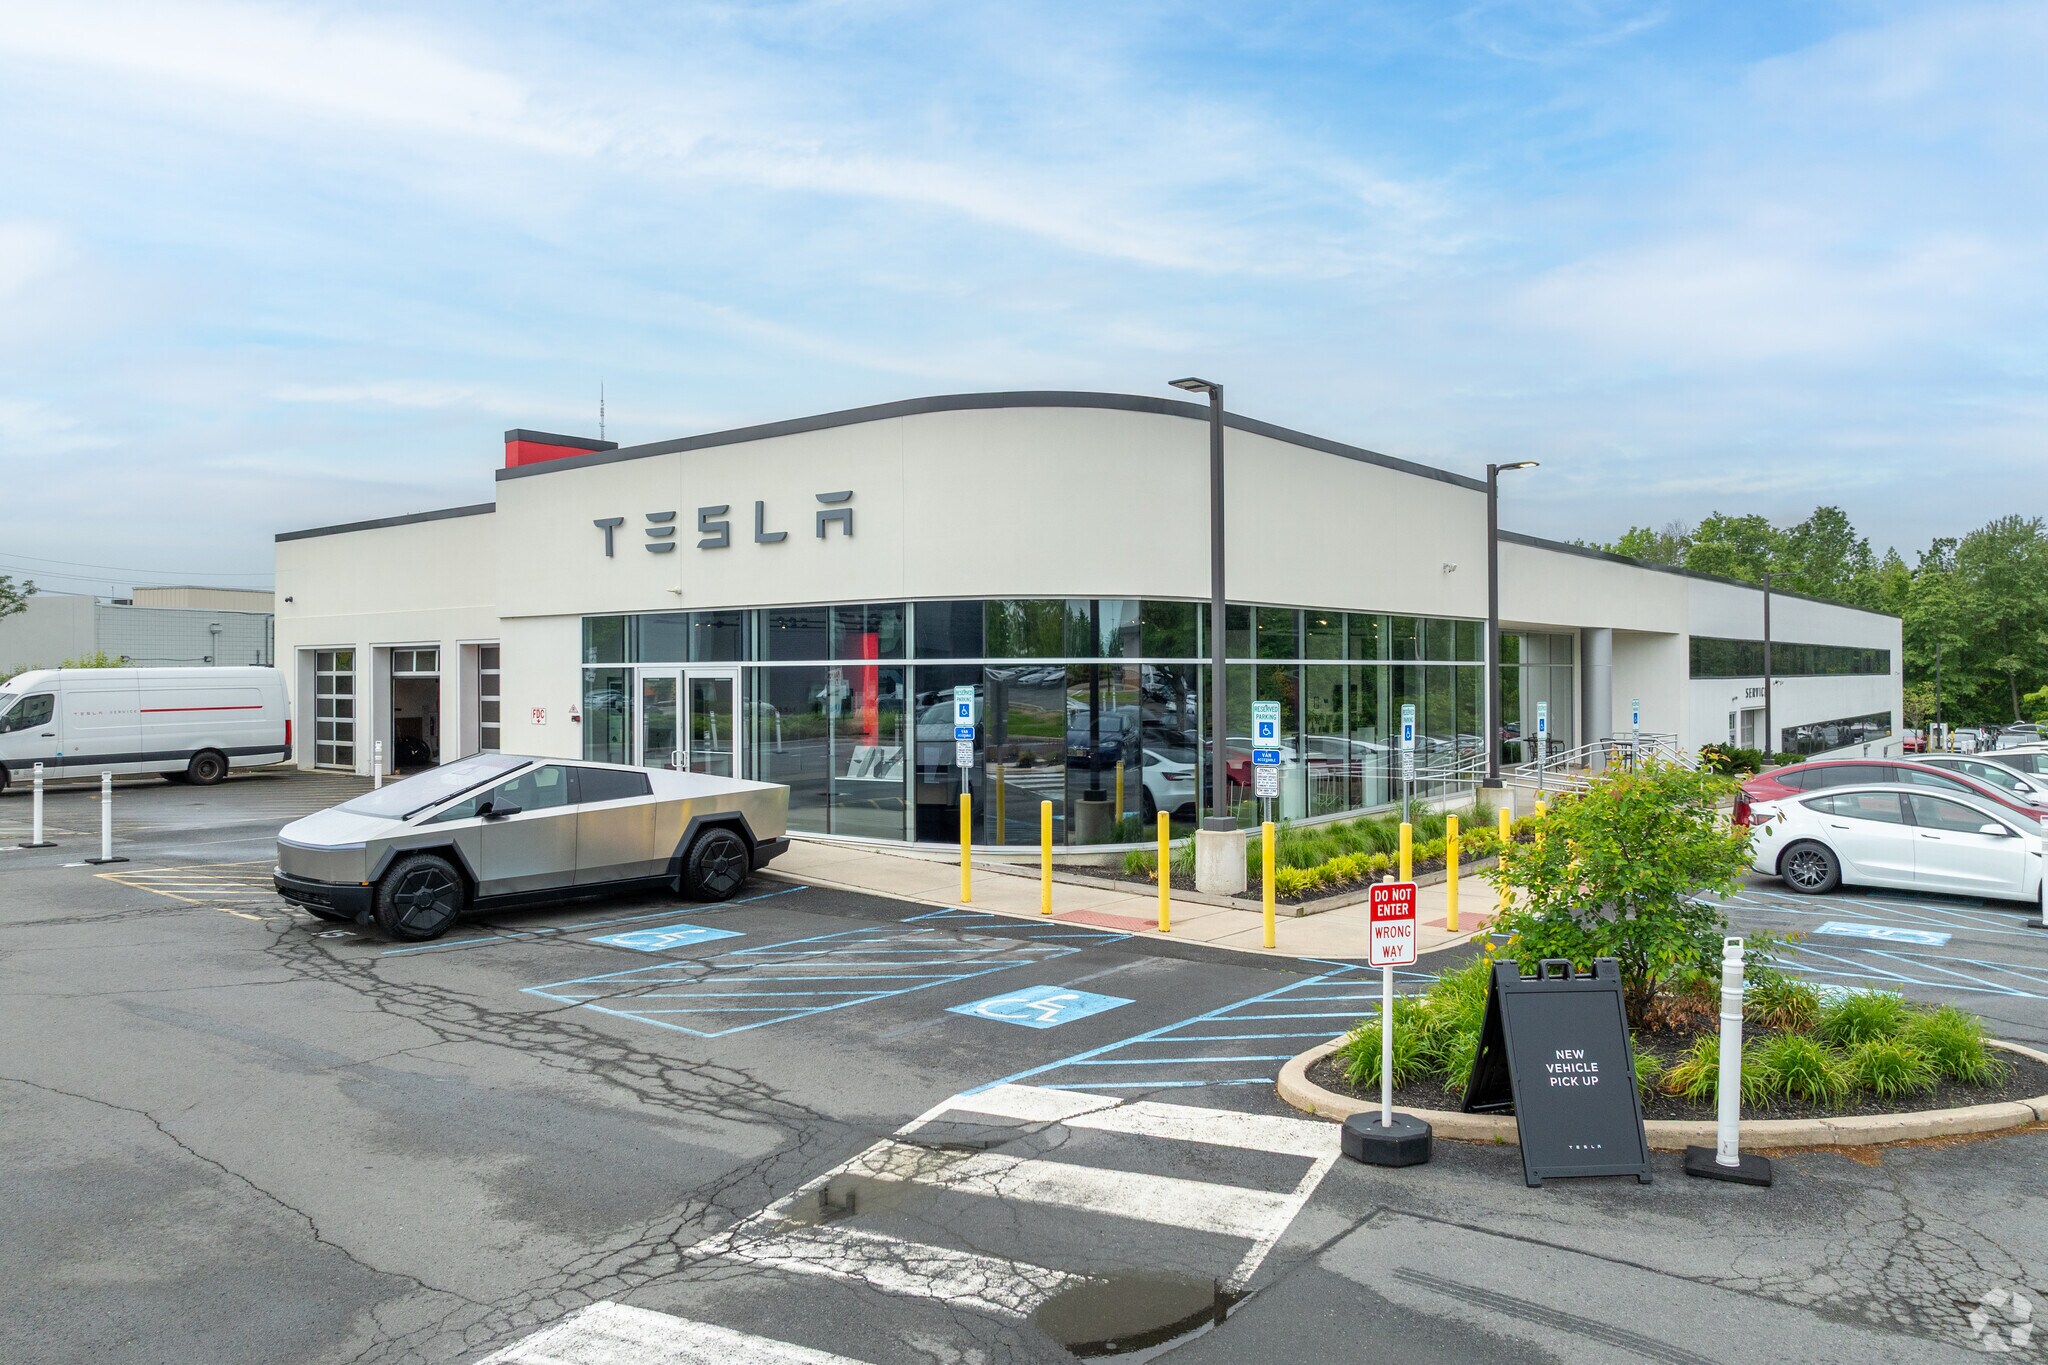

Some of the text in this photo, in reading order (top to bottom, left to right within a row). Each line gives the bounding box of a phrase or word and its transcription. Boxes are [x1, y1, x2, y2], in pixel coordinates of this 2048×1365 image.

[593, 490, 853, 558] TESLA
[532, 709, 545, 719] FDC
[1254, 705, 1279, 713] RESERVED
[1374, 888, 1412, 902] DO NOT
[1377, 903, 1409, 917] ENTER
[1375, 925, 1411, 939] WRONG
[1382, 945, 1403, 958] WAY
[1555, 1049, 1585, 1060] NEW
[1545, 1062, 1599, 1074] VEHICLE
[1550, 1076, 1599, 1087] PICK UP
